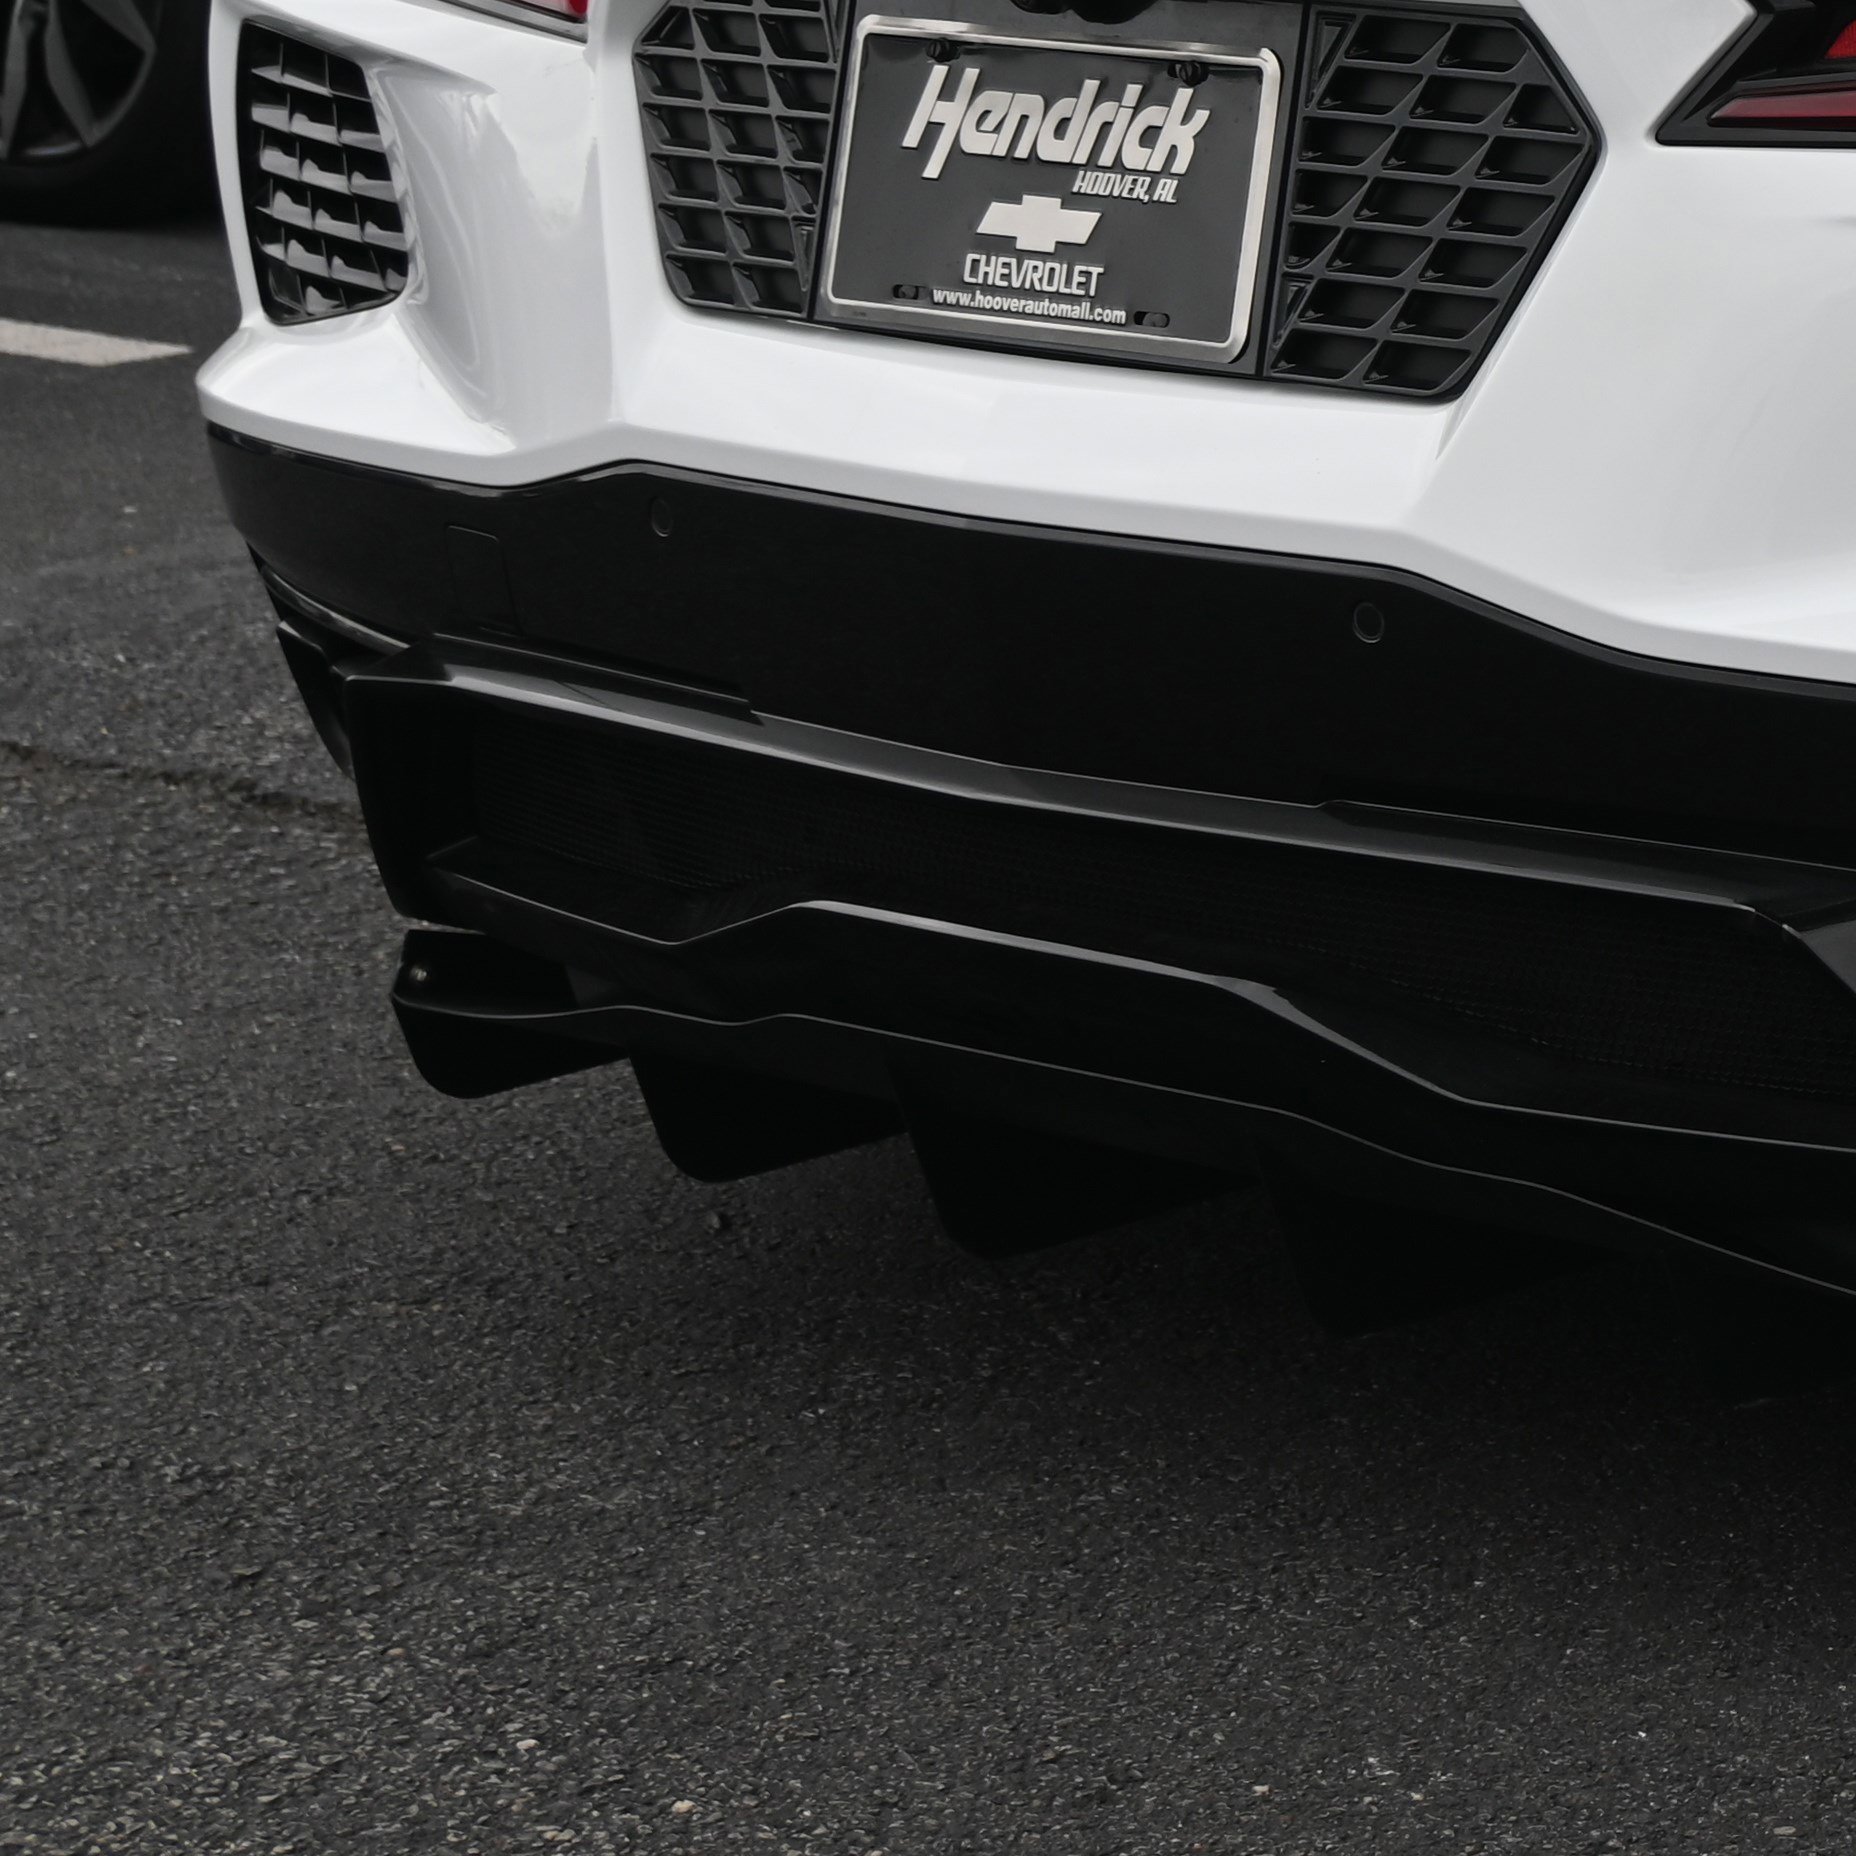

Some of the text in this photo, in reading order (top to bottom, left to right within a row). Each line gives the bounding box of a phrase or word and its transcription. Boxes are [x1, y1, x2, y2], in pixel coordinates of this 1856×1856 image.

[902, 63, 1211, 180] Hendrick
[1072, 170, 1179, 204] HOOVER, AL
[963, 252, 1105, 298] CHEVROLET
[932, 287, 1127, 326] www.hooverautomall.com
